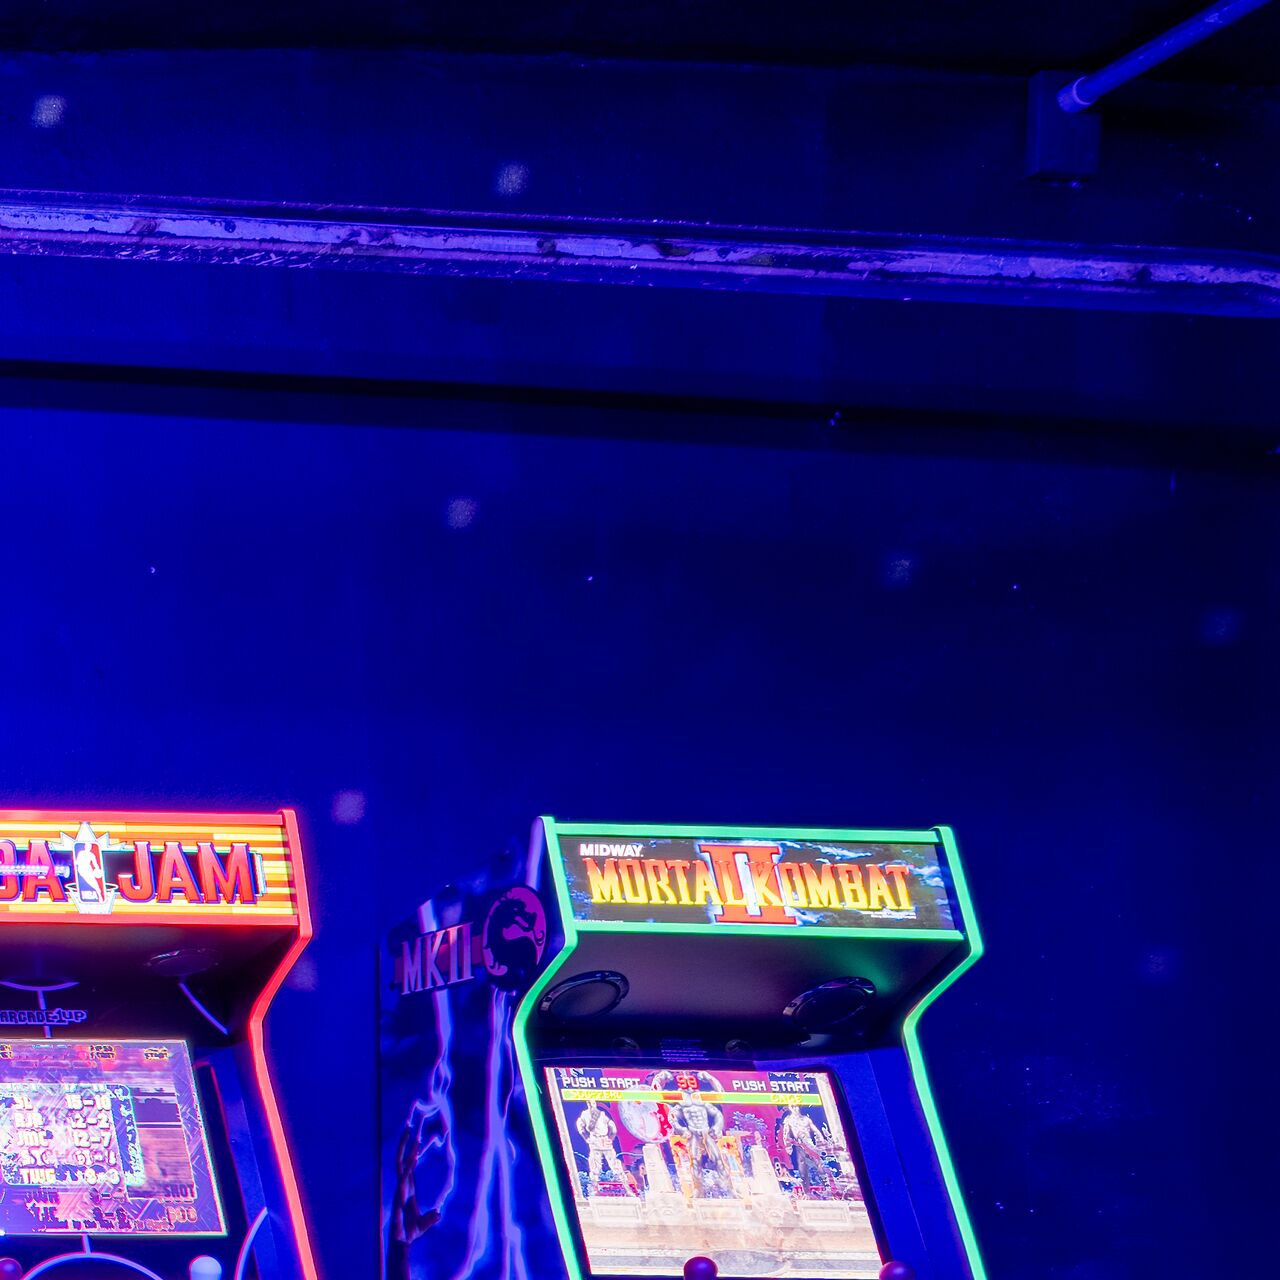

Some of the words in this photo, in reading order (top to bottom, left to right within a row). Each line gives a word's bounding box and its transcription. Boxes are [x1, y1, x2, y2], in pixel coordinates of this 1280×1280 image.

[579, 843, 644, 858] MIDWAY
[118, 842, 259, 905] JAM
[584, 858, 752, 907] MORTAL
[743, 861, 915, 911] KOMBAT
[401, 921, 475, 996] MKII
[0, 1008, 88, 1025] ARCADE1UP
[562, 1077, 596, 1088] PUSH
[600, 1077, 641, 1089] START
[732, 1080, 766, 1091] PUSH
[770, 1081, 811, 1092] START
